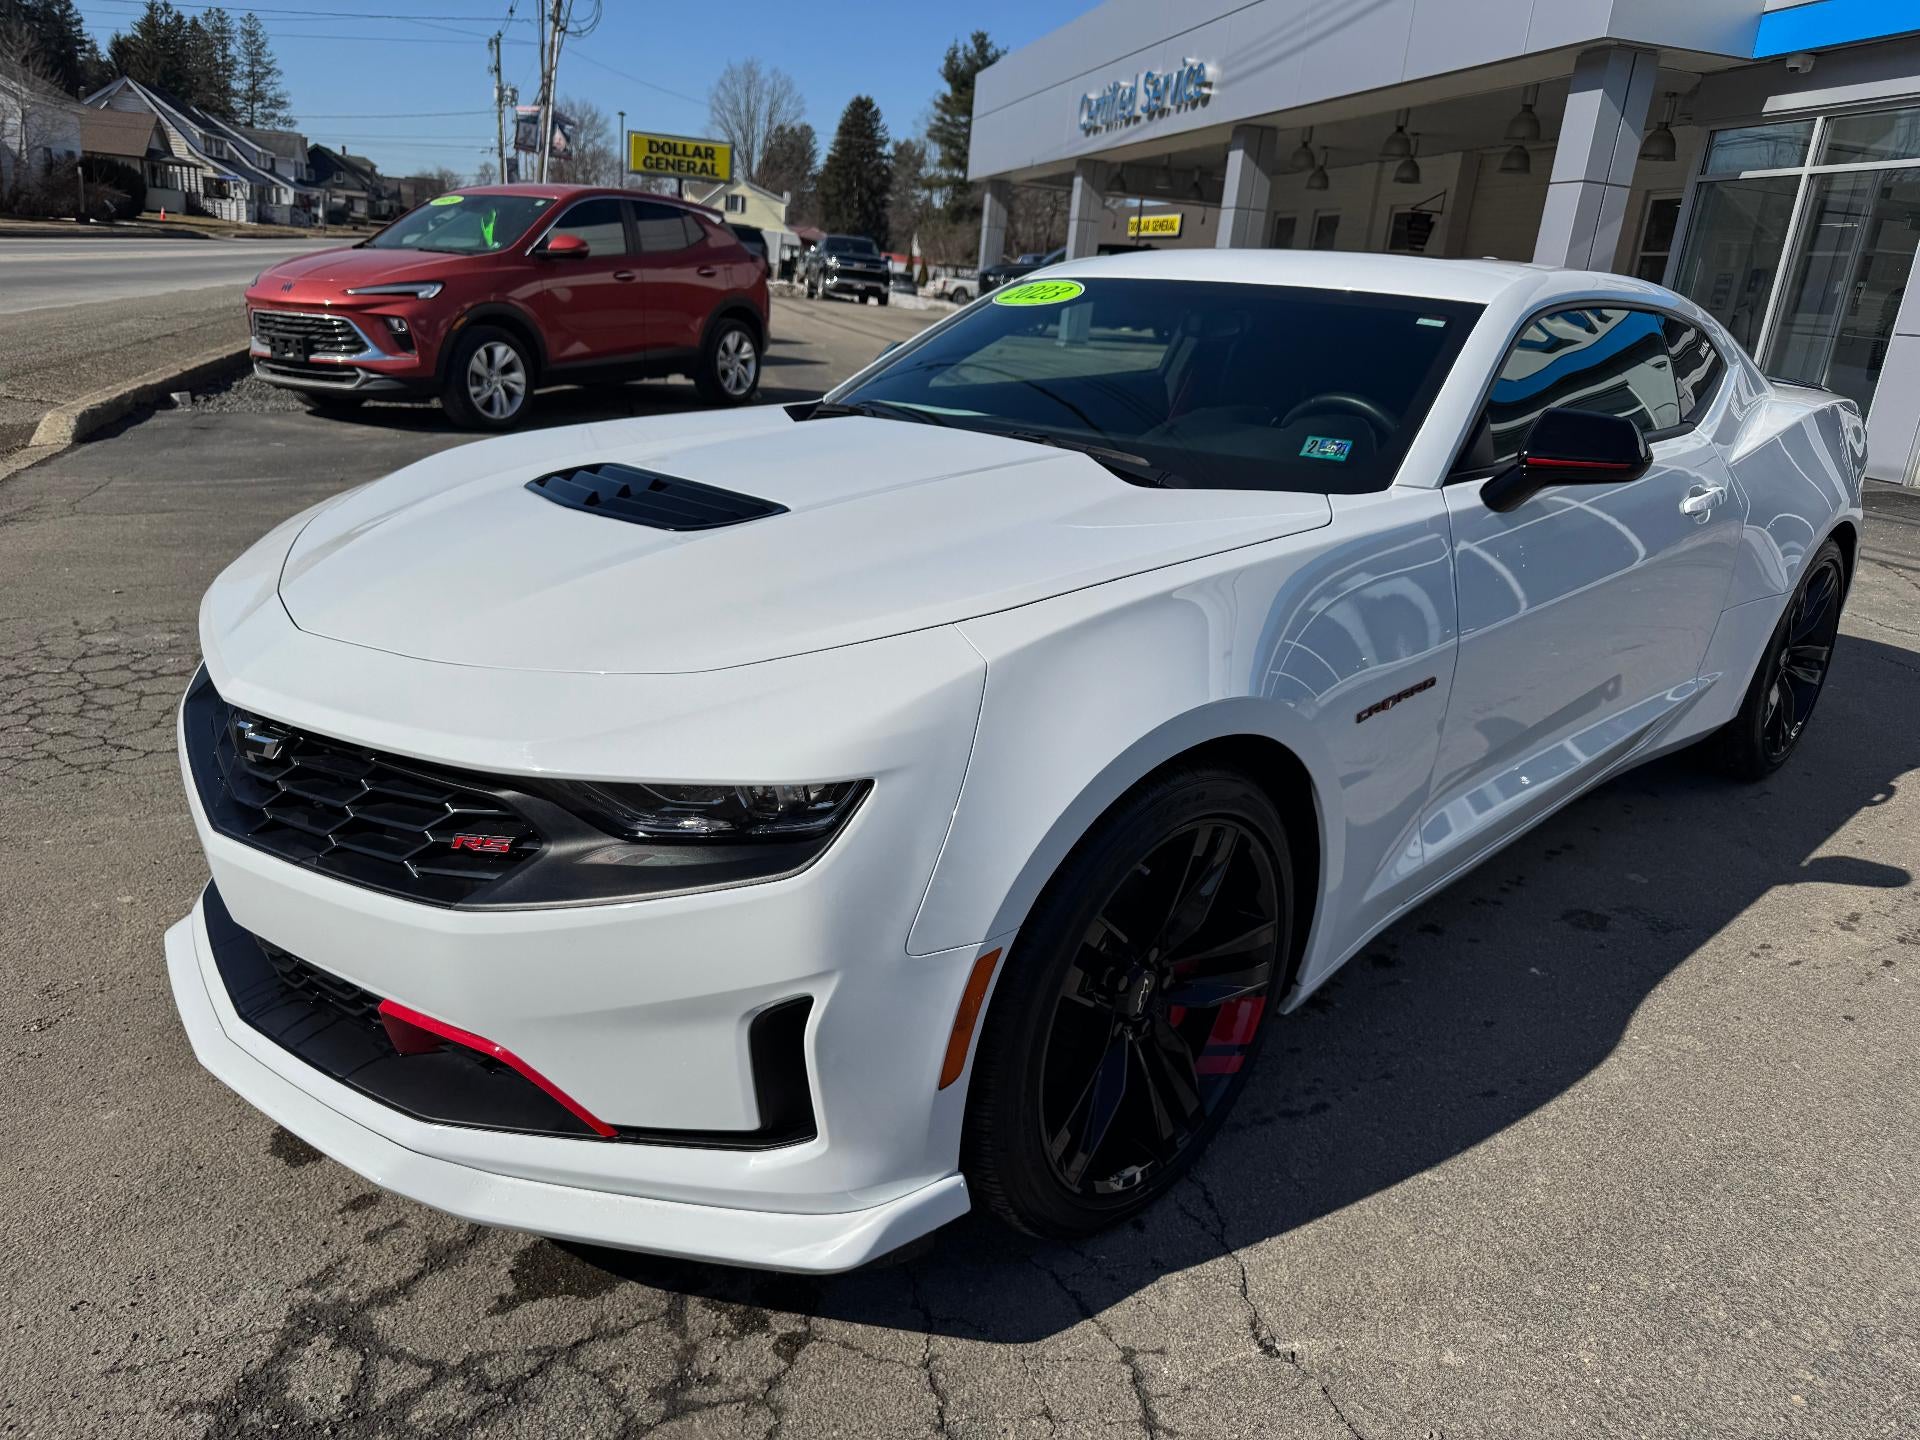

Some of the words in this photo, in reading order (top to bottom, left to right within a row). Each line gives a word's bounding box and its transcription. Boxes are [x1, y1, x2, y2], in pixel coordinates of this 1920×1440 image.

[1079, 73, 1139, 130] Certified
[1141, 57, 1207, 114] Service
[647, 139, 716, 160] DOLLAR
[642, 156, 720, 177] GENERAL
[1000, 285, 1075, 300] 2023
[1307, 439, 1319, 453] 2
[451, 833, 515, 852] RS
